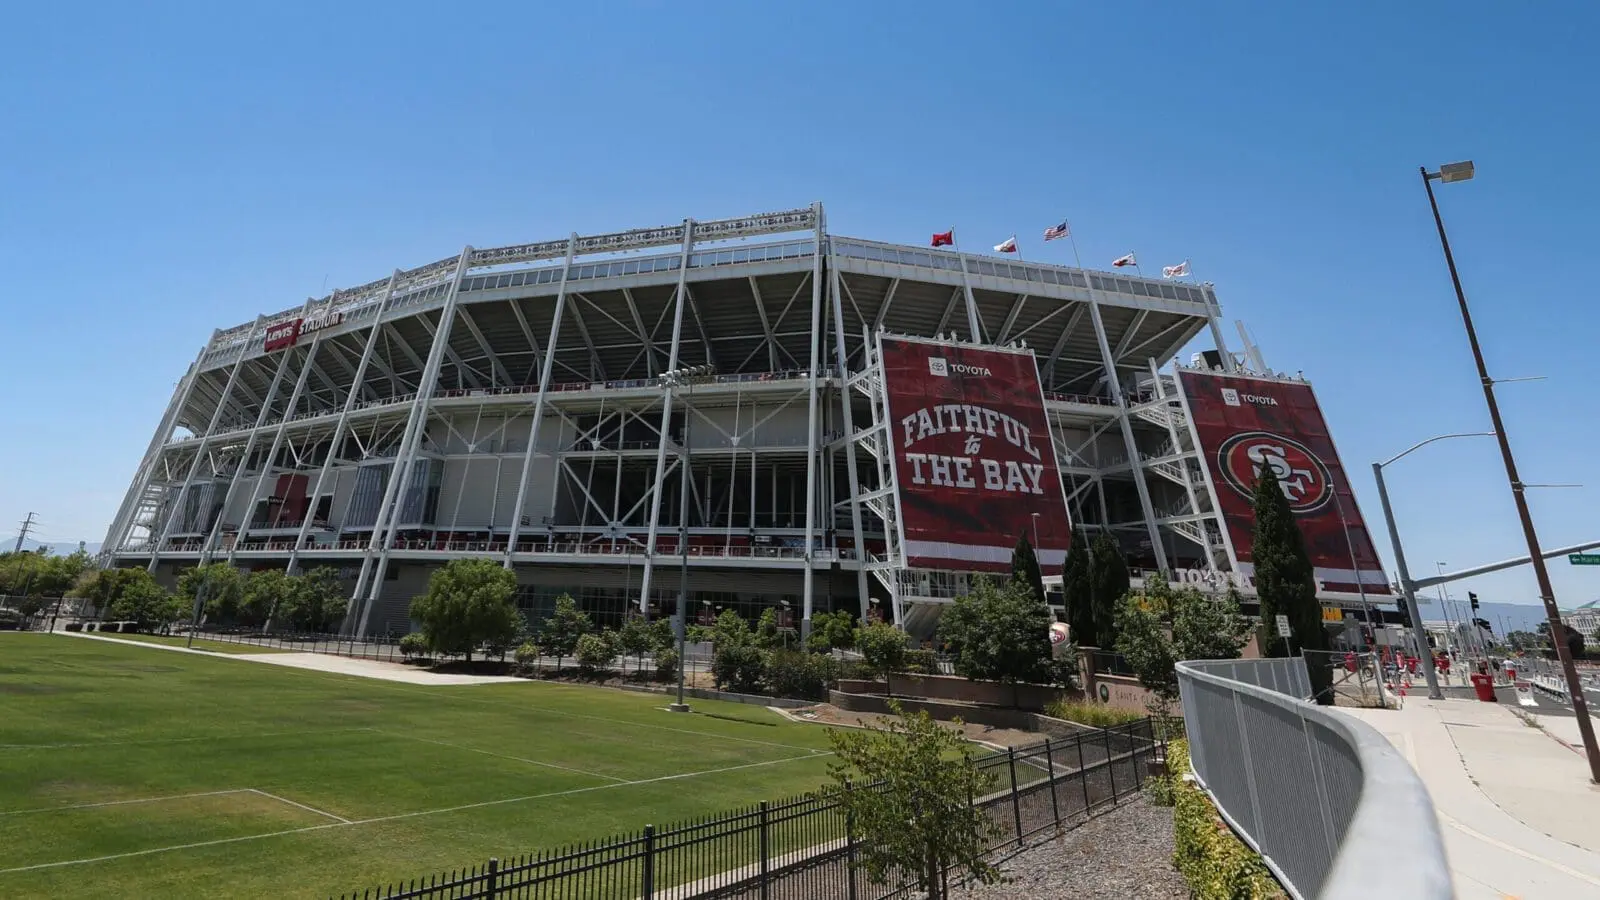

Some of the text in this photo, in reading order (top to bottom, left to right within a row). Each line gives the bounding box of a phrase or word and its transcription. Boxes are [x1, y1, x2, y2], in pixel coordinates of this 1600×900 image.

[299, 313, 340, 334] STADIUM
[951, 364, 992, 376] TOYOTA
[1241, 394, 1278, 406] TOYOTA
[902, 404, 1041, 461] FAITHFUL
[964, 435, 981, 455] to
[906, 453, 1044, 495] THE BAY
[1175, 567, 1256, 591] TOOA
